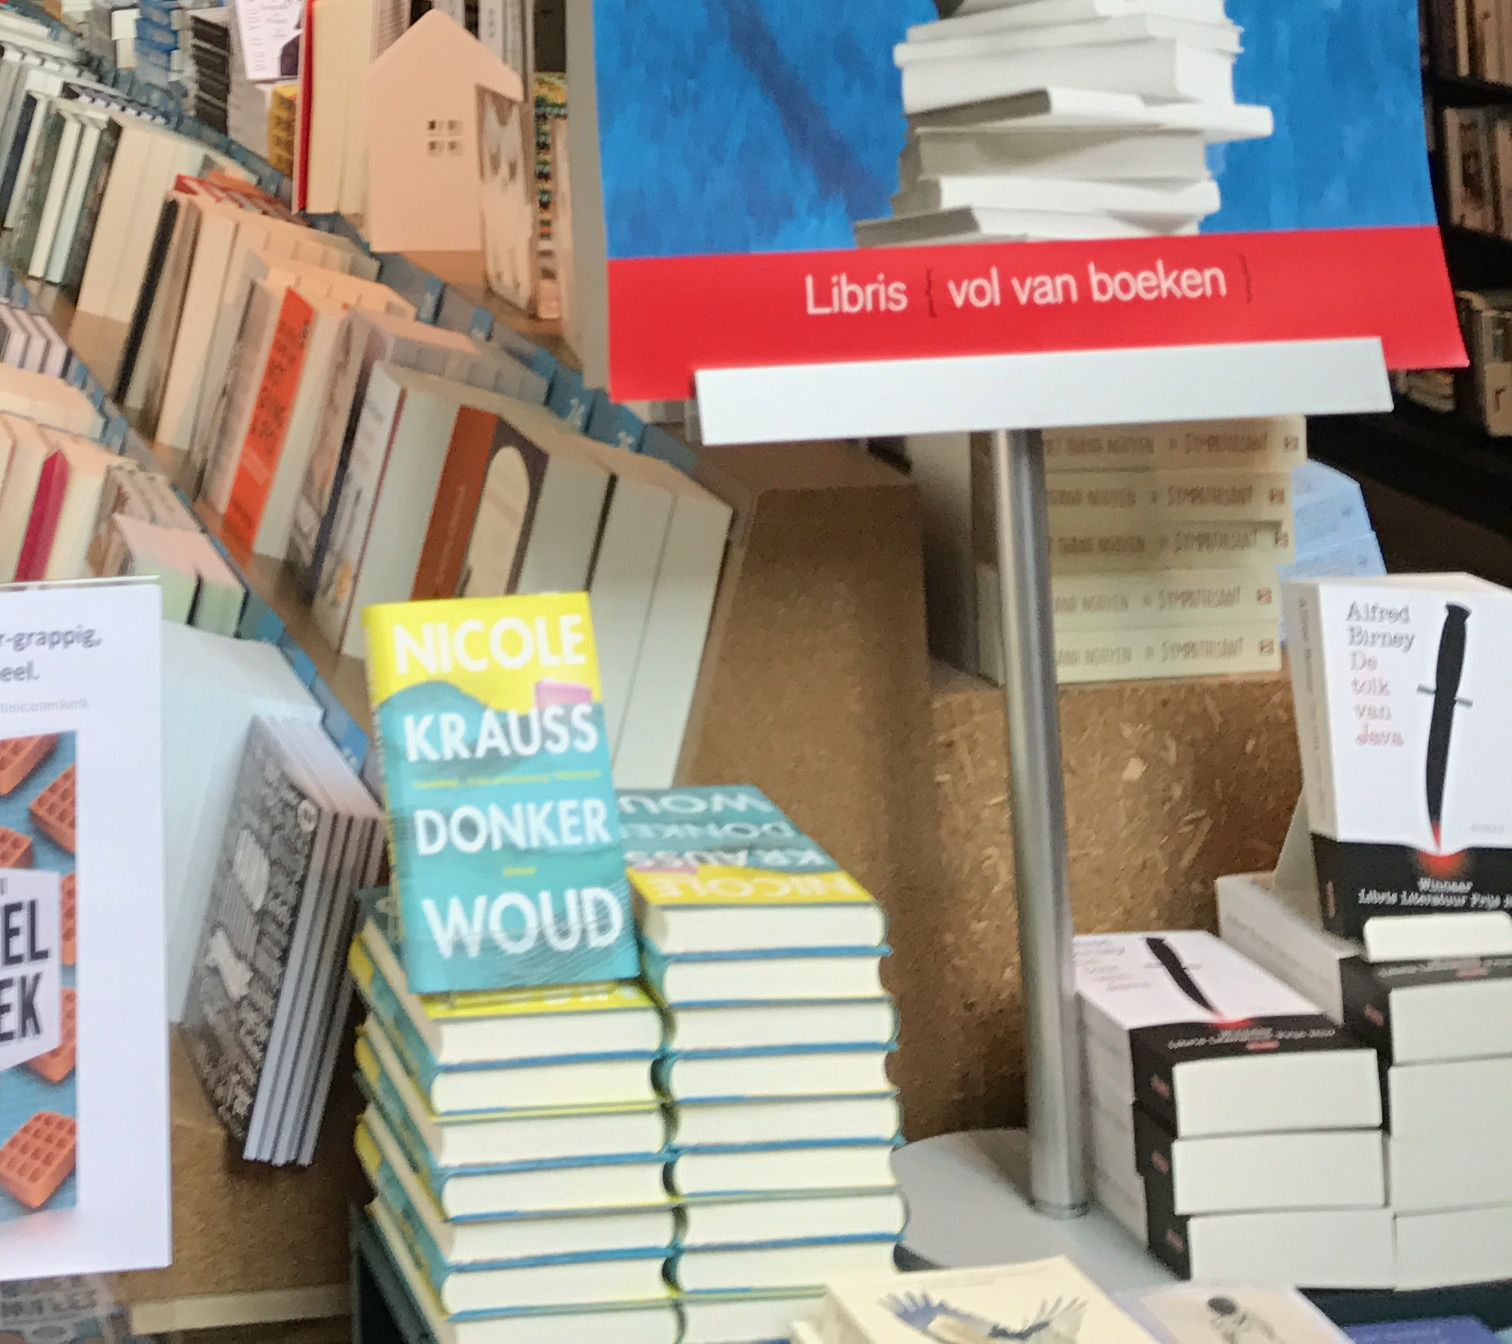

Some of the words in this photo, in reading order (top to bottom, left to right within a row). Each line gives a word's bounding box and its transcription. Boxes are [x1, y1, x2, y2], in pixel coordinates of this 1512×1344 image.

[804, 272, 909, 318] Libris
[946, 266, 1002, 310] vol
[1009, 270, 1079, 308] van
[1086, 258, 1229, 305] boeken
[1345, 601, 1411, 624] Alfred
[392, 614, 587, 676] NICOLE
[1347, 625, 1416, 652] Birney
[1349, 651, 1378, 672] De
[1350, 677, 1391, 697] tolk
[1353, 704, 1392, 721] van
[403, 703, 599, 762] KRAUSS
[1355, 725, 1404, 748] Java
[618, 793, 775, 815] WOU
[413, 798, 613, 857] DONKER
[420, 886, 624, 960] WOUD
